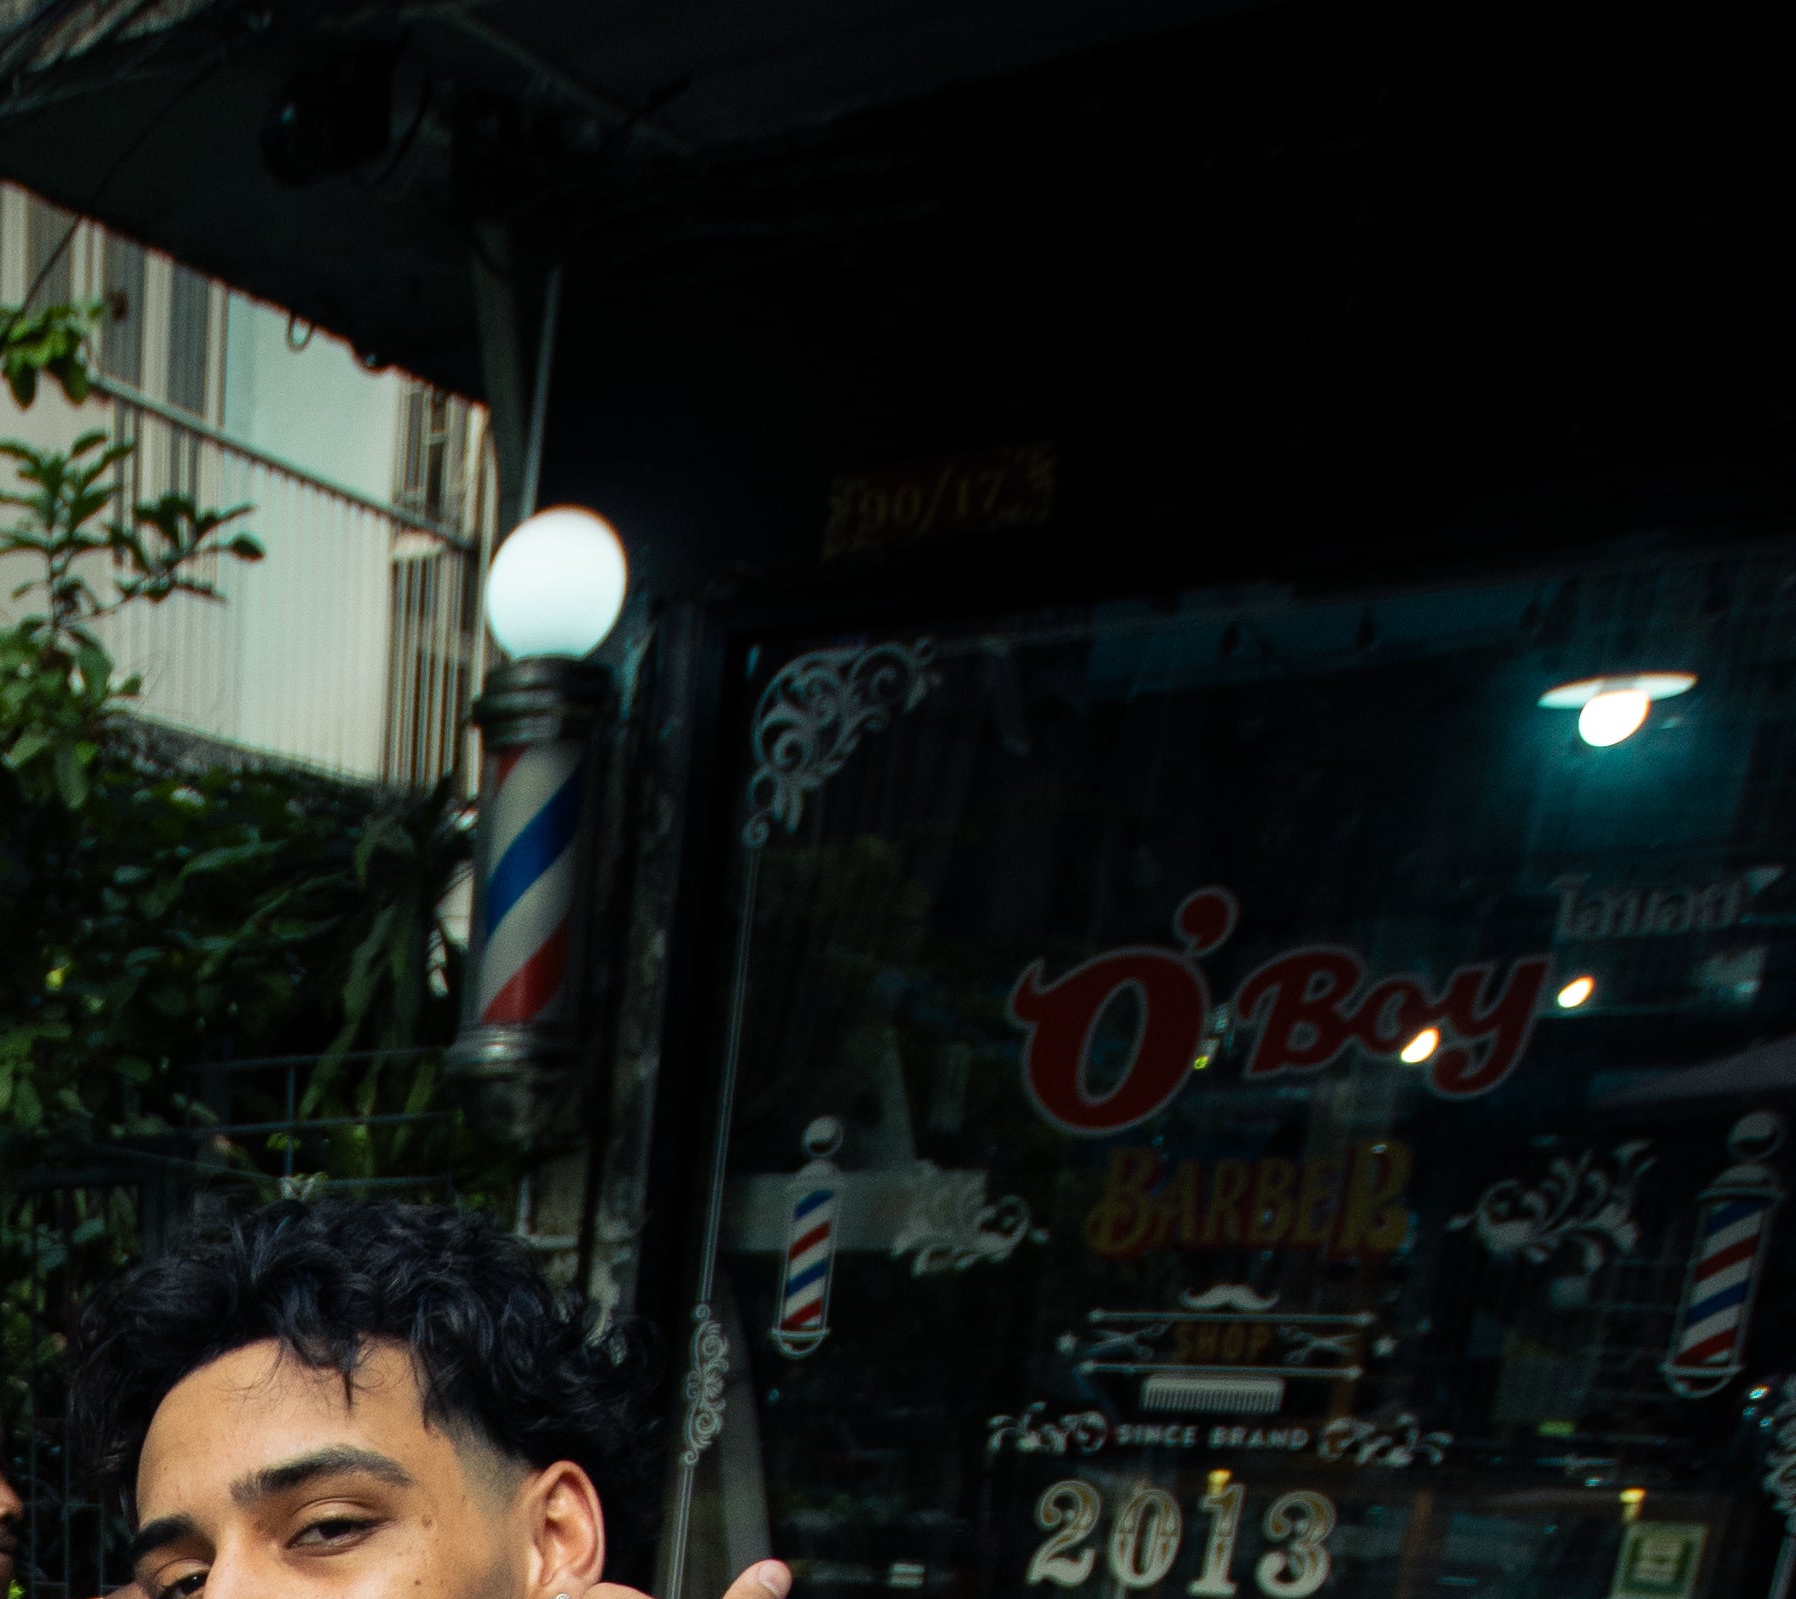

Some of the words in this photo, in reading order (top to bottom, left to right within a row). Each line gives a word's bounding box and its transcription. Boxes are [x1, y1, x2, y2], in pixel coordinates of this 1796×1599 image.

[1085, 1140, 1415, 1261] BARBER
[1172, 1320, 1275, 1364] SHOP
[1114, 1423, 1201, 1449] SINCE
[1206, 1424, 1312, 1451] BRAND
[1024, 1476, 1341, 1599] 2013
